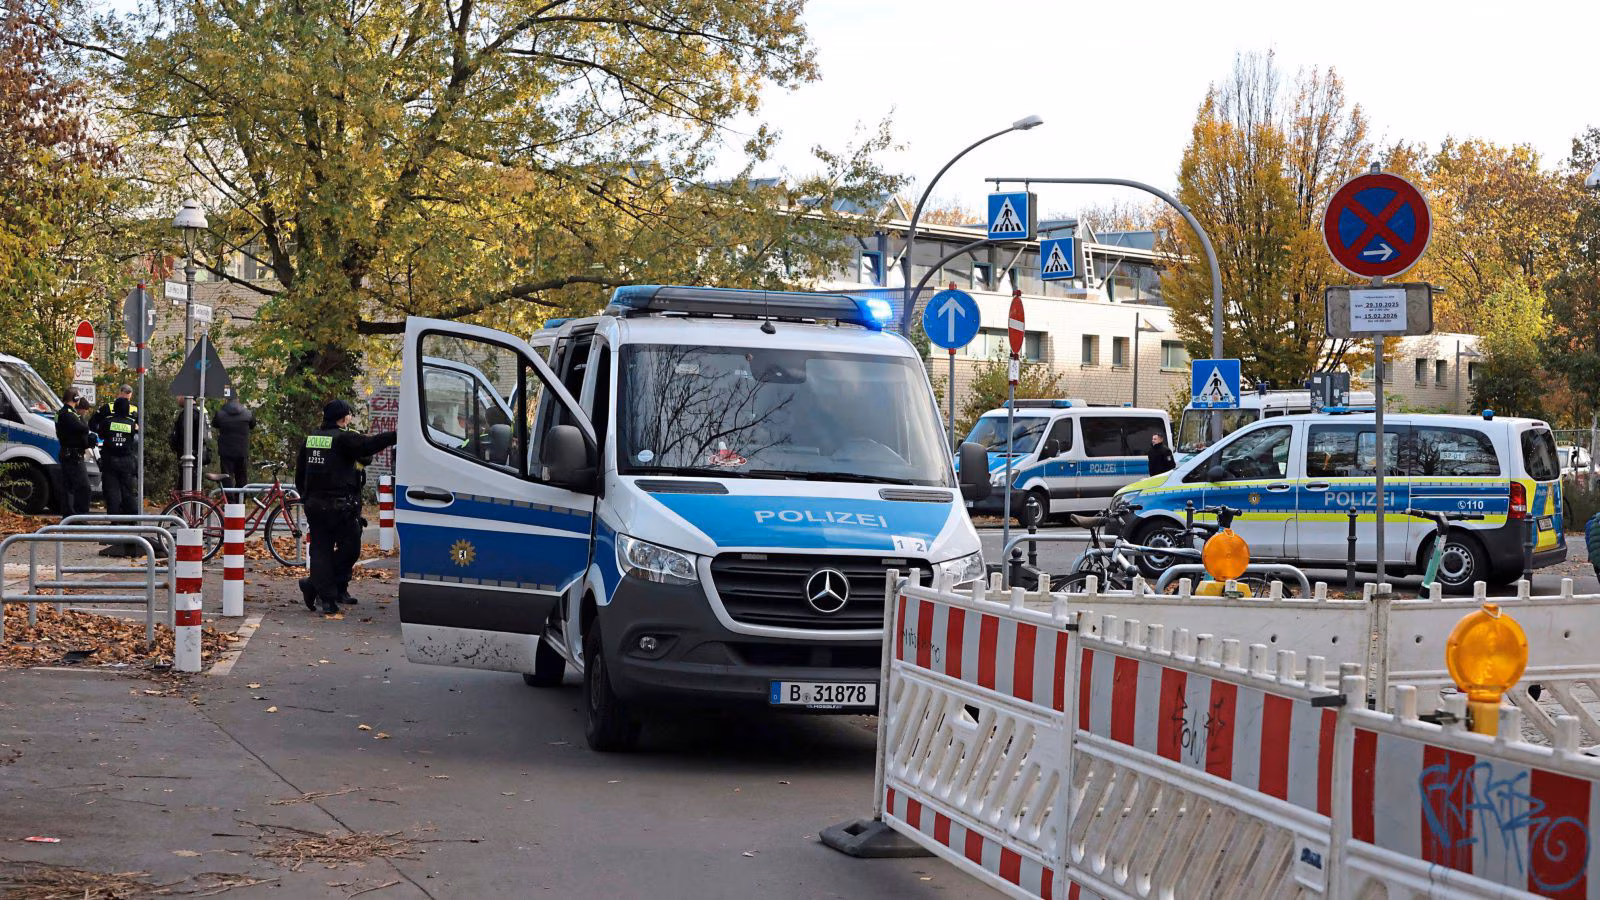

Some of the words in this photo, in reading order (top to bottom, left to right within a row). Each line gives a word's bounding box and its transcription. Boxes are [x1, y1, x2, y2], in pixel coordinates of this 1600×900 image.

[1090, 464, 1116, 472] POLIZEI
[1324, 492, 1394, 506] POLIZEI
[1466, 500, 1484, 509] 110
[754, 510, 888, 528] POLIZEI
[790, 685, 800, 702] B
[814, 686, 866, 702] 31878
